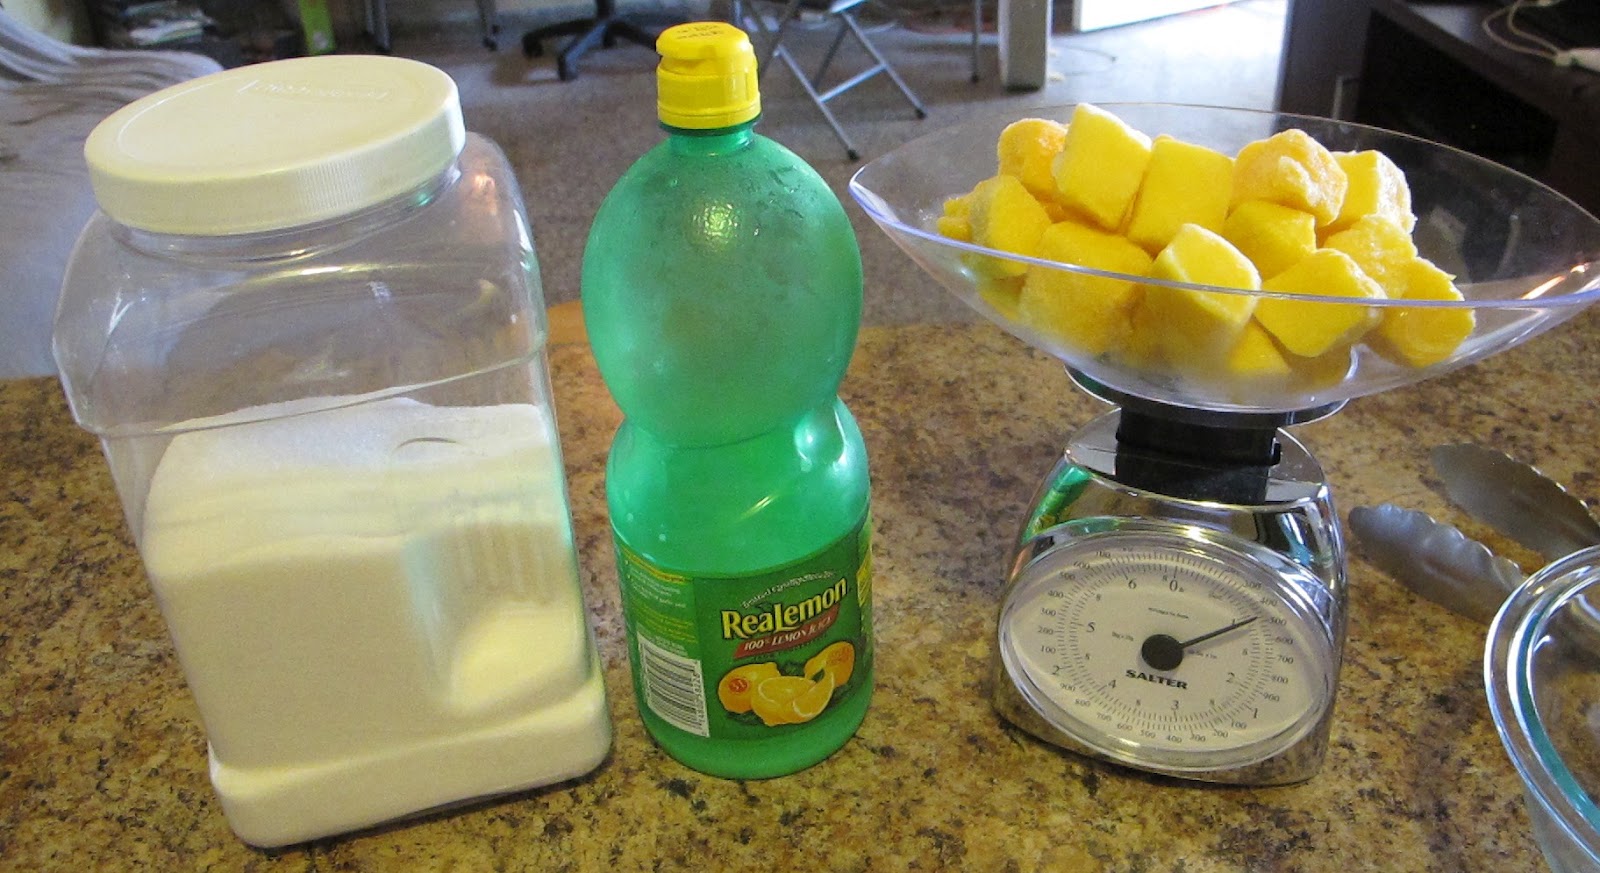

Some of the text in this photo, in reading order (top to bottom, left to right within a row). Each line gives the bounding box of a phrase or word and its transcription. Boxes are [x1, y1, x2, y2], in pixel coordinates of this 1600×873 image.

[1128, 578, 1137, 590] 6
[1169, 579, 1178, 592] 0
[721, 577, 847, 639] ReaLemon
[1038, 625, 1054, 635] 200
[1086, 621, 1096, 633] 5
[772, 629, 807, 646] LEMON
[1041, 645, 1056, 655] 100
[1278, 655, 1294, 664] 700
[1052, 665, 1060, 676] 2
[1125, 669, 1188, 690] SALTER
[1226, 672, 1235, 683] 2
[1060, 683, 1076, 692] 900
[1108, 679, 1117, 689] 4
[1263, 691, 1280, 702] 900
[1171, 700, 1179, 711] 3
[1252, 708, 1258, 719] 1
[1117, 723, 1133, 731] 600
[1231, 720, 1247, 729] 100
[1167, 735, 1182, 744] 400
